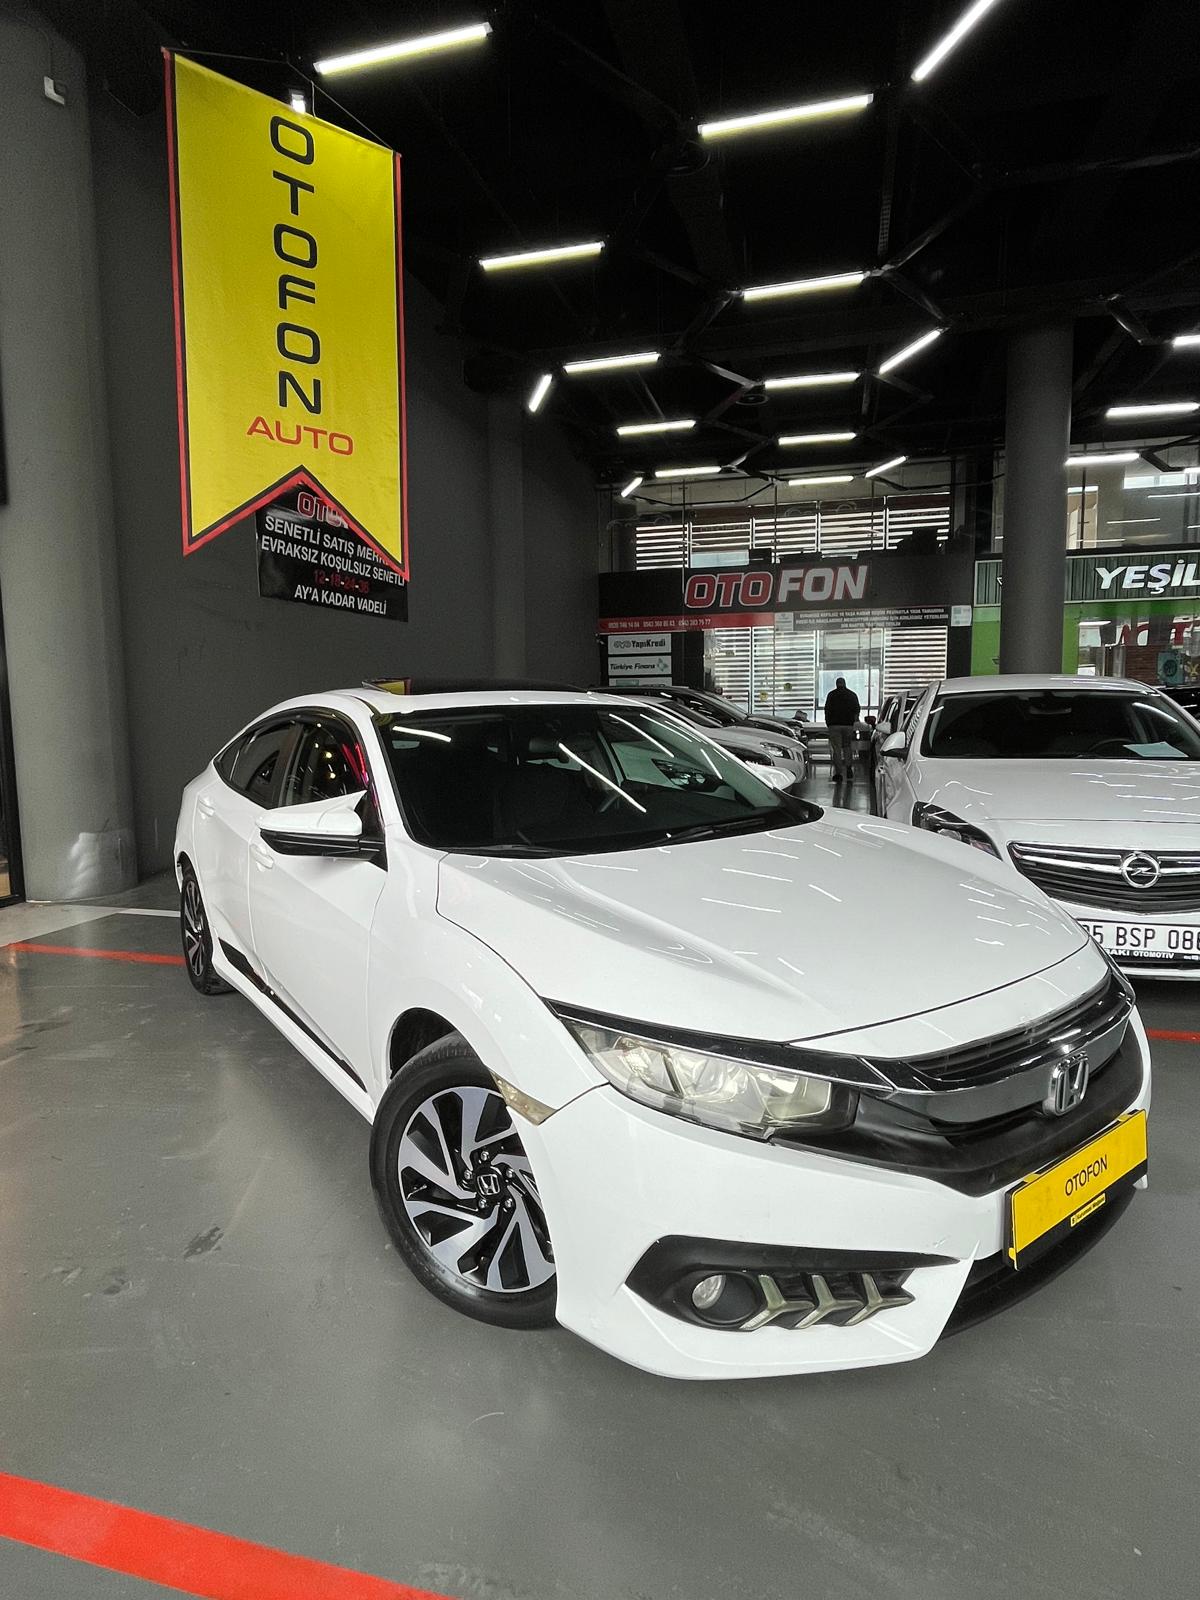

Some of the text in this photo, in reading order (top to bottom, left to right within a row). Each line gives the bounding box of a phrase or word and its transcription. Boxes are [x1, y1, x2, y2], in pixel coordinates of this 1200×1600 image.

[269, 115, 323, 415] OTOFON
[246, 415, 354, 456] AUTO
[261, 535, 318, 564] EVRAKSIZ
[320, 552, 371, 578] KOŞULSUZ
[265, 515, 321, 545] SENETLİ
[323, 534, 355, 558] SATIŞ
[1095, 559, 1200, 594] YEŞİL
[321, 590, 355, 609] KADAR
[357, 597, 387, 615] VADELİ
[1116, 926, 1156, 948] BSP
[1167, 929, 1200, 951] 08
[1065, 1154, 1108, 1197] OTOFON
